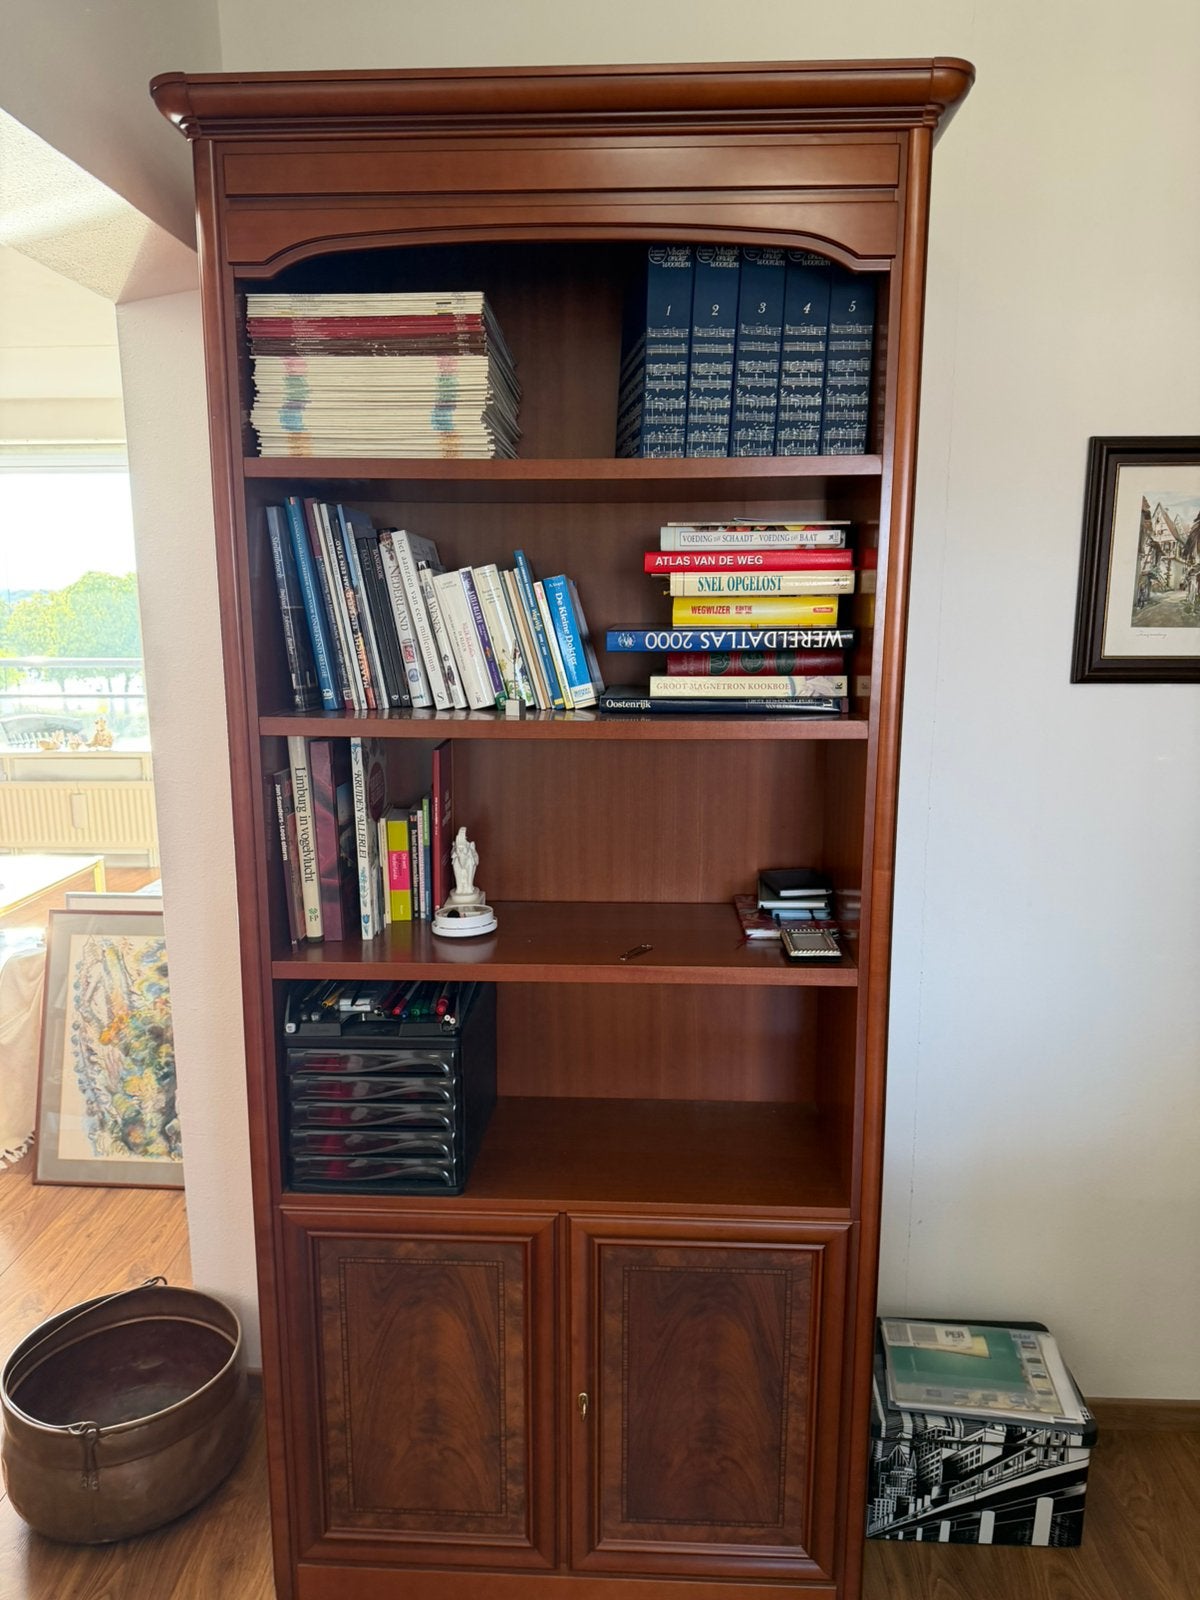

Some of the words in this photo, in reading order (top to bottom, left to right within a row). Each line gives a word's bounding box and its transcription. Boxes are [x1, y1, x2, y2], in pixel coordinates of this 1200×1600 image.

[666, 305, 672, 316] 1
[711, 304, 720, 316] 2
[758, 302, 767, 314] 3
[803, 302, 812, 314] 4
[848, 301, 857, 312] 5
[396, 538, 406, 553] het
[682, 534, 714, 543] VOEDING
[722, 534, 753, 543] SCHAADT
[759, 533, 790, 542] VOEDING
[799, 533, 818, 542] BAAT
[271, 535, 284, 578] Stellenbosch
[372, 548, 383, 580] BANGKOK
[655, 556, 690, 566] ATLAS
[693, 556, 716, 565] VAN
[719, 555, 734, 565] DE
[737, 555, 763, 565] WEG
[400, 555, 414, 588] aanzien
[697, 577, 725, 592] SNEL
[727, 575, 783, 592] OPGELOST
[388, 564, 411, 631] NEDERLAND
[409, 590, 418, 605] van
[554, 591, 565, 607] De
[414, 607, 423, 622] een
[427, 600, 443, 634] WENEN
[691, 606, 730, 615] WEGWIJZER
[557, 606, 572, 634] Kleine
[419, 624, 437, 672] millennium
[645, 632, 693, 649] 2000
[700, 630, 844, 649] WERELDATLAS
[564, 634, 579, 666] Dokter
[353, 633, 370, 688] MAASTRICHT
[689, 682, 747, 690] MAGNETRON
[605, 699, 651, 709] Oostenrijk
[292, 766, 309, 812] Limburg
[354, 769, 364, 812] KRUIDEN
[276, 796, 284, 822] Sanders
[299, 815, 310, 825] in
[356, 815, 367, 858] ALLERLEI
[297, 826, 315, 882] vogelvlucht
